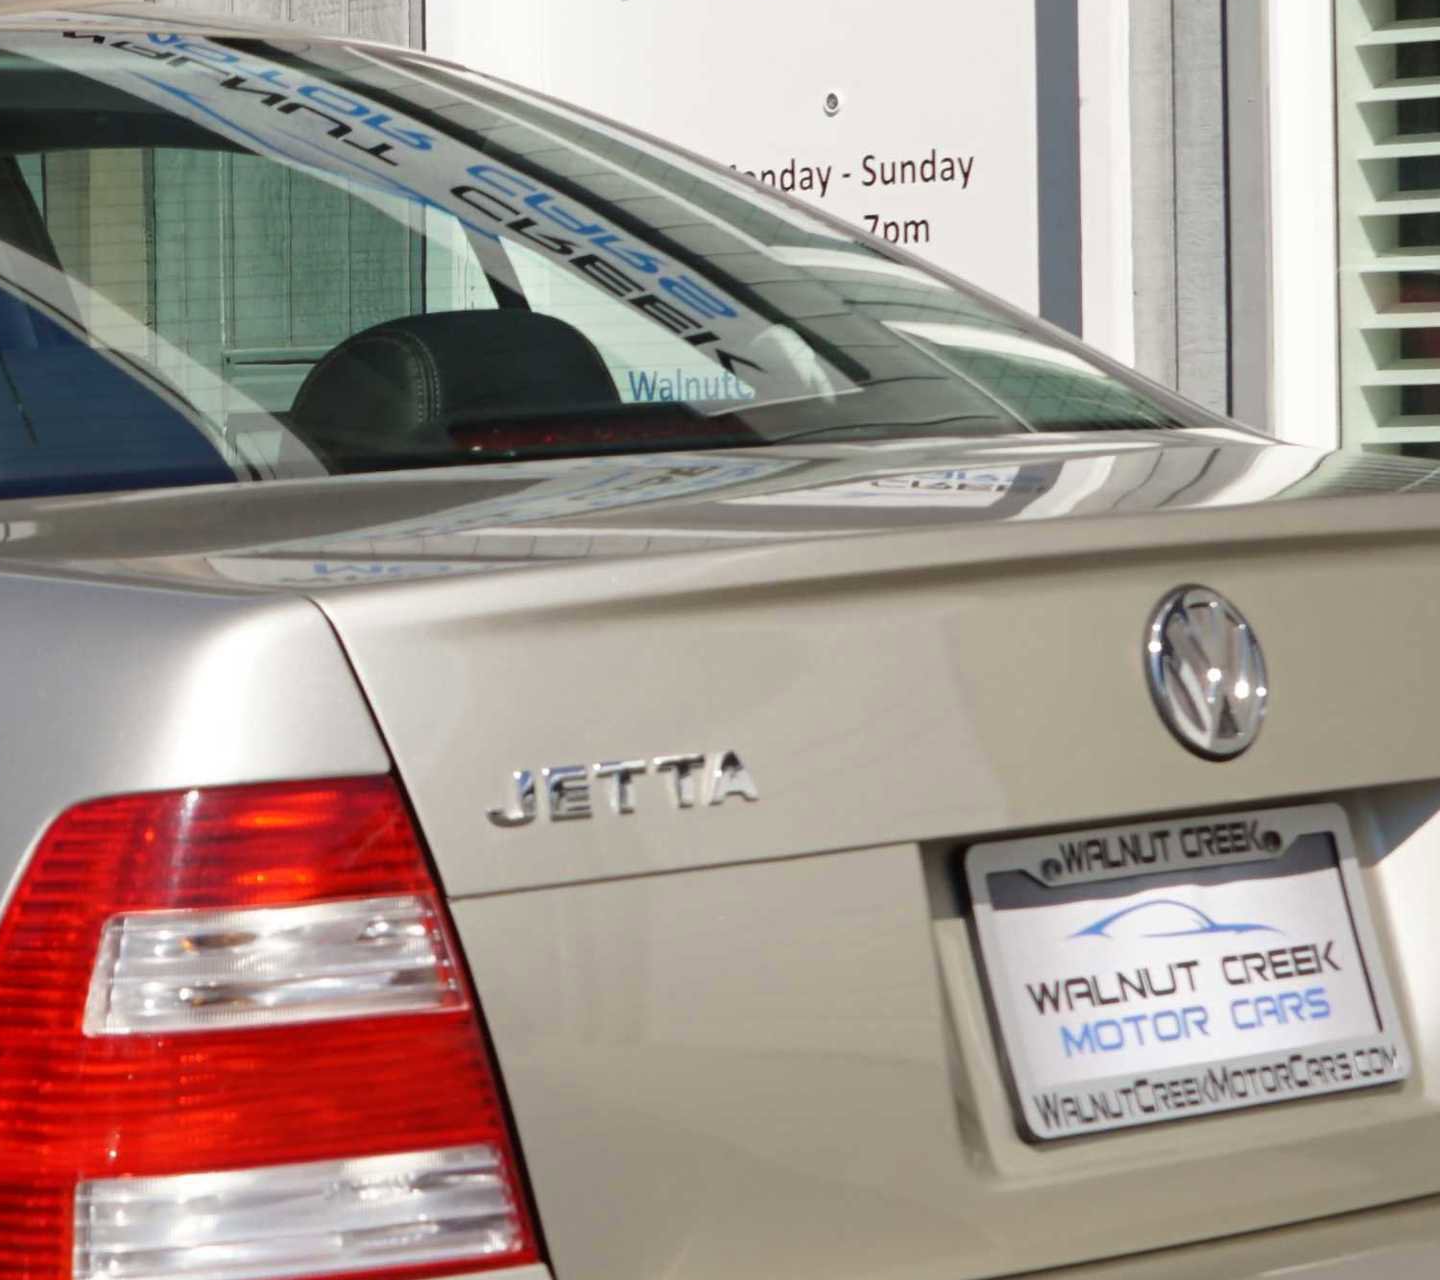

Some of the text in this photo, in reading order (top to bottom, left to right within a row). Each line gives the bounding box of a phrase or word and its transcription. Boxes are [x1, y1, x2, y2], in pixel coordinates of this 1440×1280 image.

[727, 157, 832, 197] nday
[861, 148, 974, 190] Sunday
[486, 750, 760, 828] JETTA
[1058, 819, 1266, 873] WALNUT CREEK
[1025, 940, 1342, 1015] WALNUT CREEK
[1059, 986, 1331, 1058] MOTOR CARS
